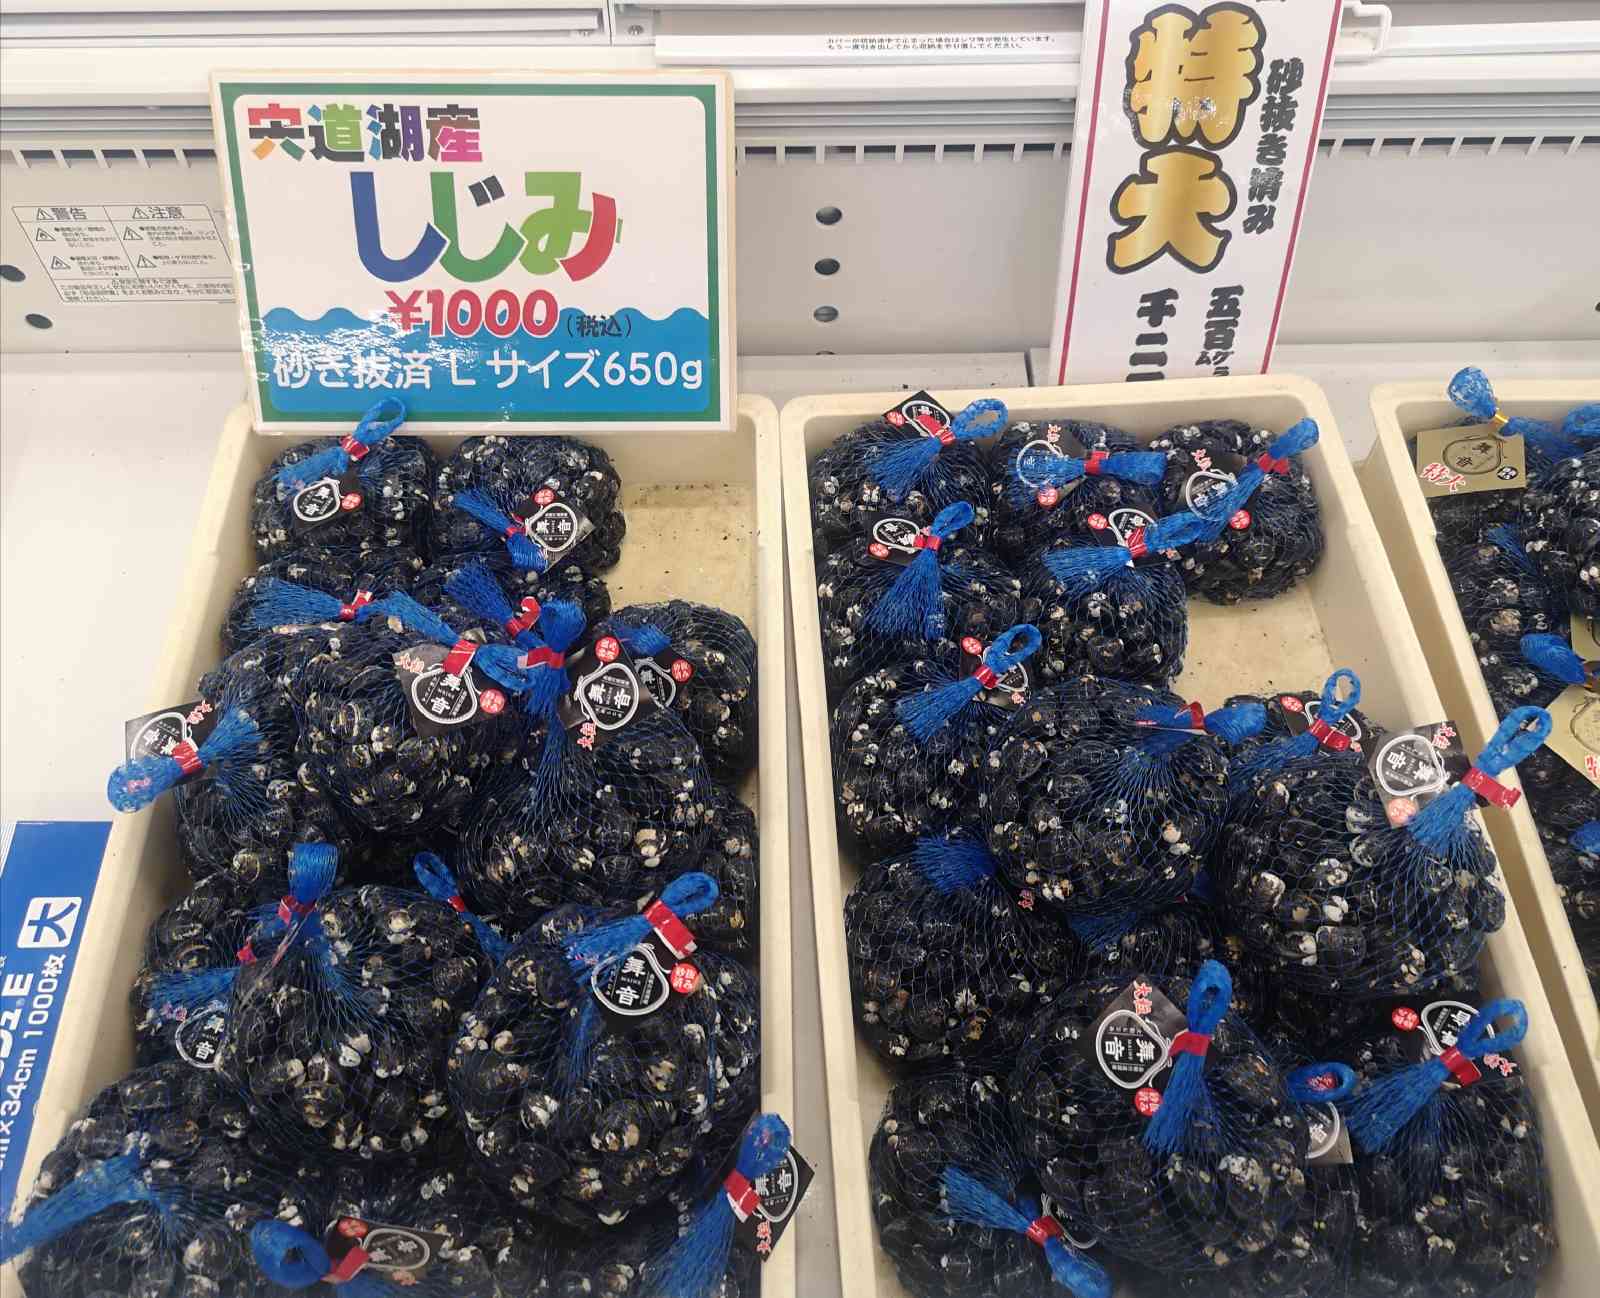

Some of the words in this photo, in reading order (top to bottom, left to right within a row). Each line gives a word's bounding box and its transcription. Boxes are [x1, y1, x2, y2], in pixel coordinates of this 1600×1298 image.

[247, 103, 483, 162] 宍道湖産
[1106, 1, 1267, 274] 特大
[1242, 57, 1304, 234] 砂抜き済み
[50, 207, 87, 220] 警告
[150, 206, 185, 219] 注意
[349, 171, 624, 282] しじみ
[385, 289, 559, 337] ¥1000
[32, 901, 77, 944] 大
